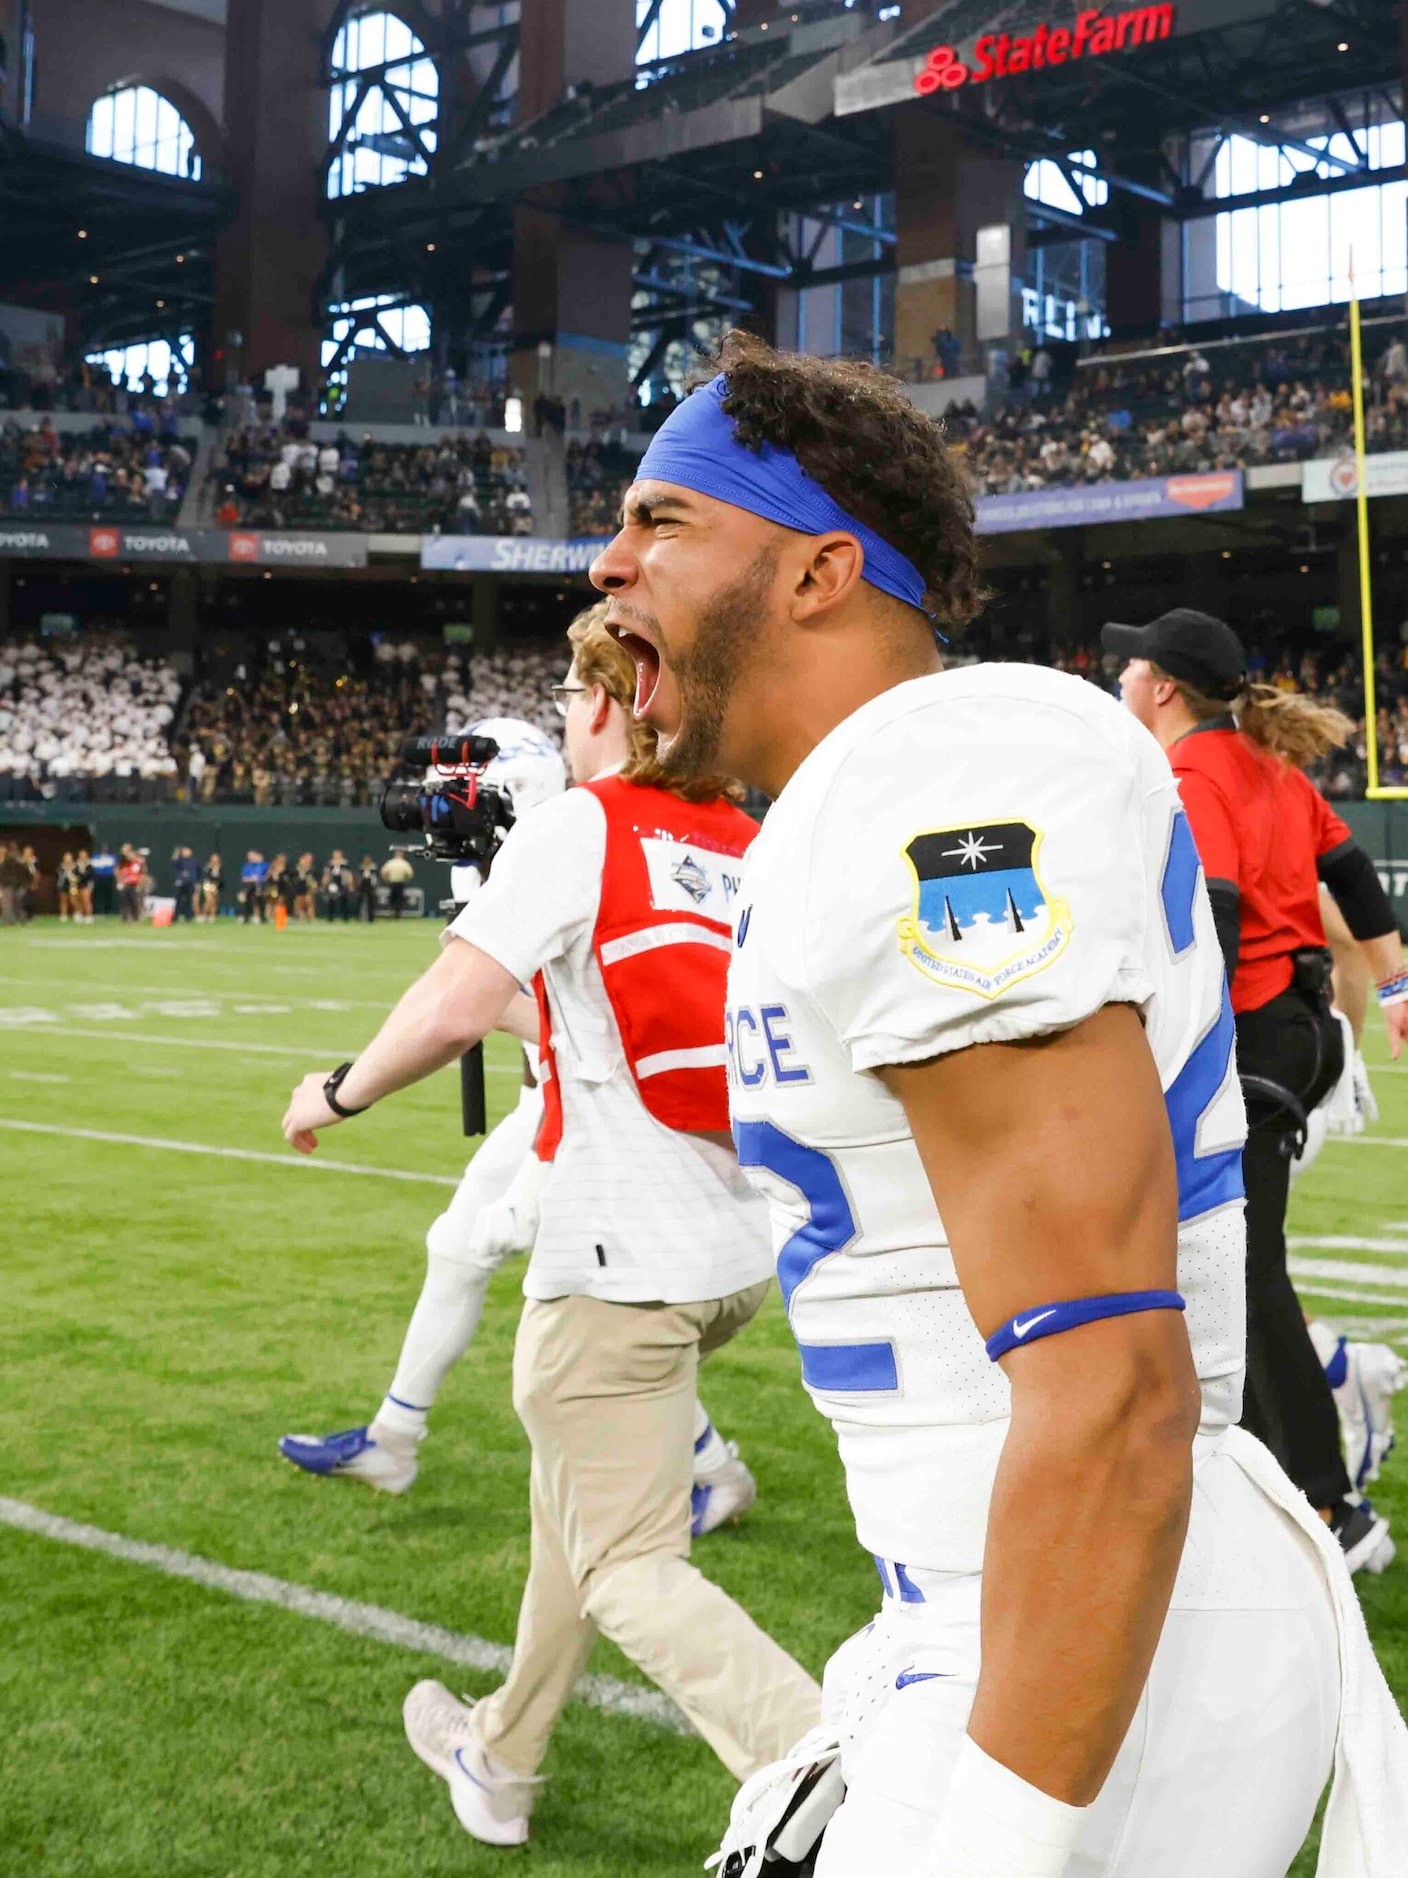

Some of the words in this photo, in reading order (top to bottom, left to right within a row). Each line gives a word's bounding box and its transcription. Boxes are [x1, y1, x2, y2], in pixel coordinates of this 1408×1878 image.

[124, 535, 190, 553] TOYOTA
[263, 541, 328, 556] TOYOTA
[912, 946, 944, 973] UNITED
[943, 963, 975, 982] STATES
[994, 961, 1024, 986] FORCE
